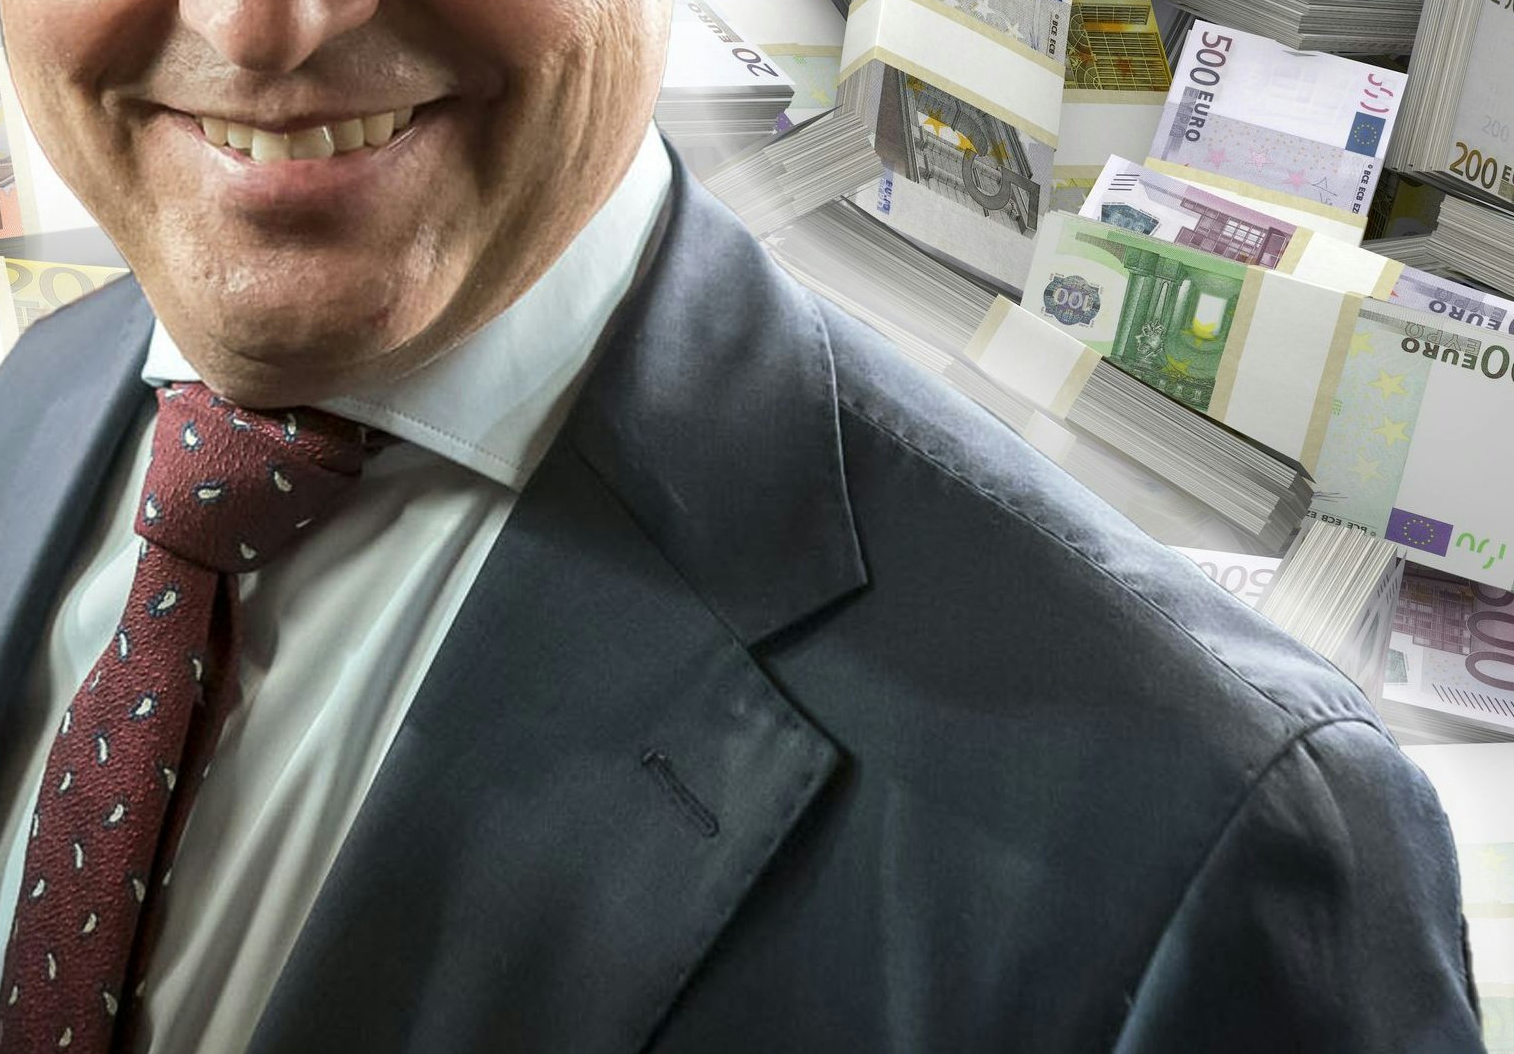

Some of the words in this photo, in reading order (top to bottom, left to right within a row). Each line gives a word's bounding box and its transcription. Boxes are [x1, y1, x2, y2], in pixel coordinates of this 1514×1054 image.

[1050, 19, 1059, 37] BCE
[1048, 37, 1057, 55] ECB
[1188, 30, 1233, 87] 500
[1184, 91, 1214, 143] EURO
[1360, 169, 1371, 186] BCE
[1448, 143, 1498, 190] 200
[1355, 186, 1367, 202] ECB
[1052, 289, 1091, 312] 100
[1428, 299, 1500, 331] EURO
[1400, 336, 1478, 371] EURO
